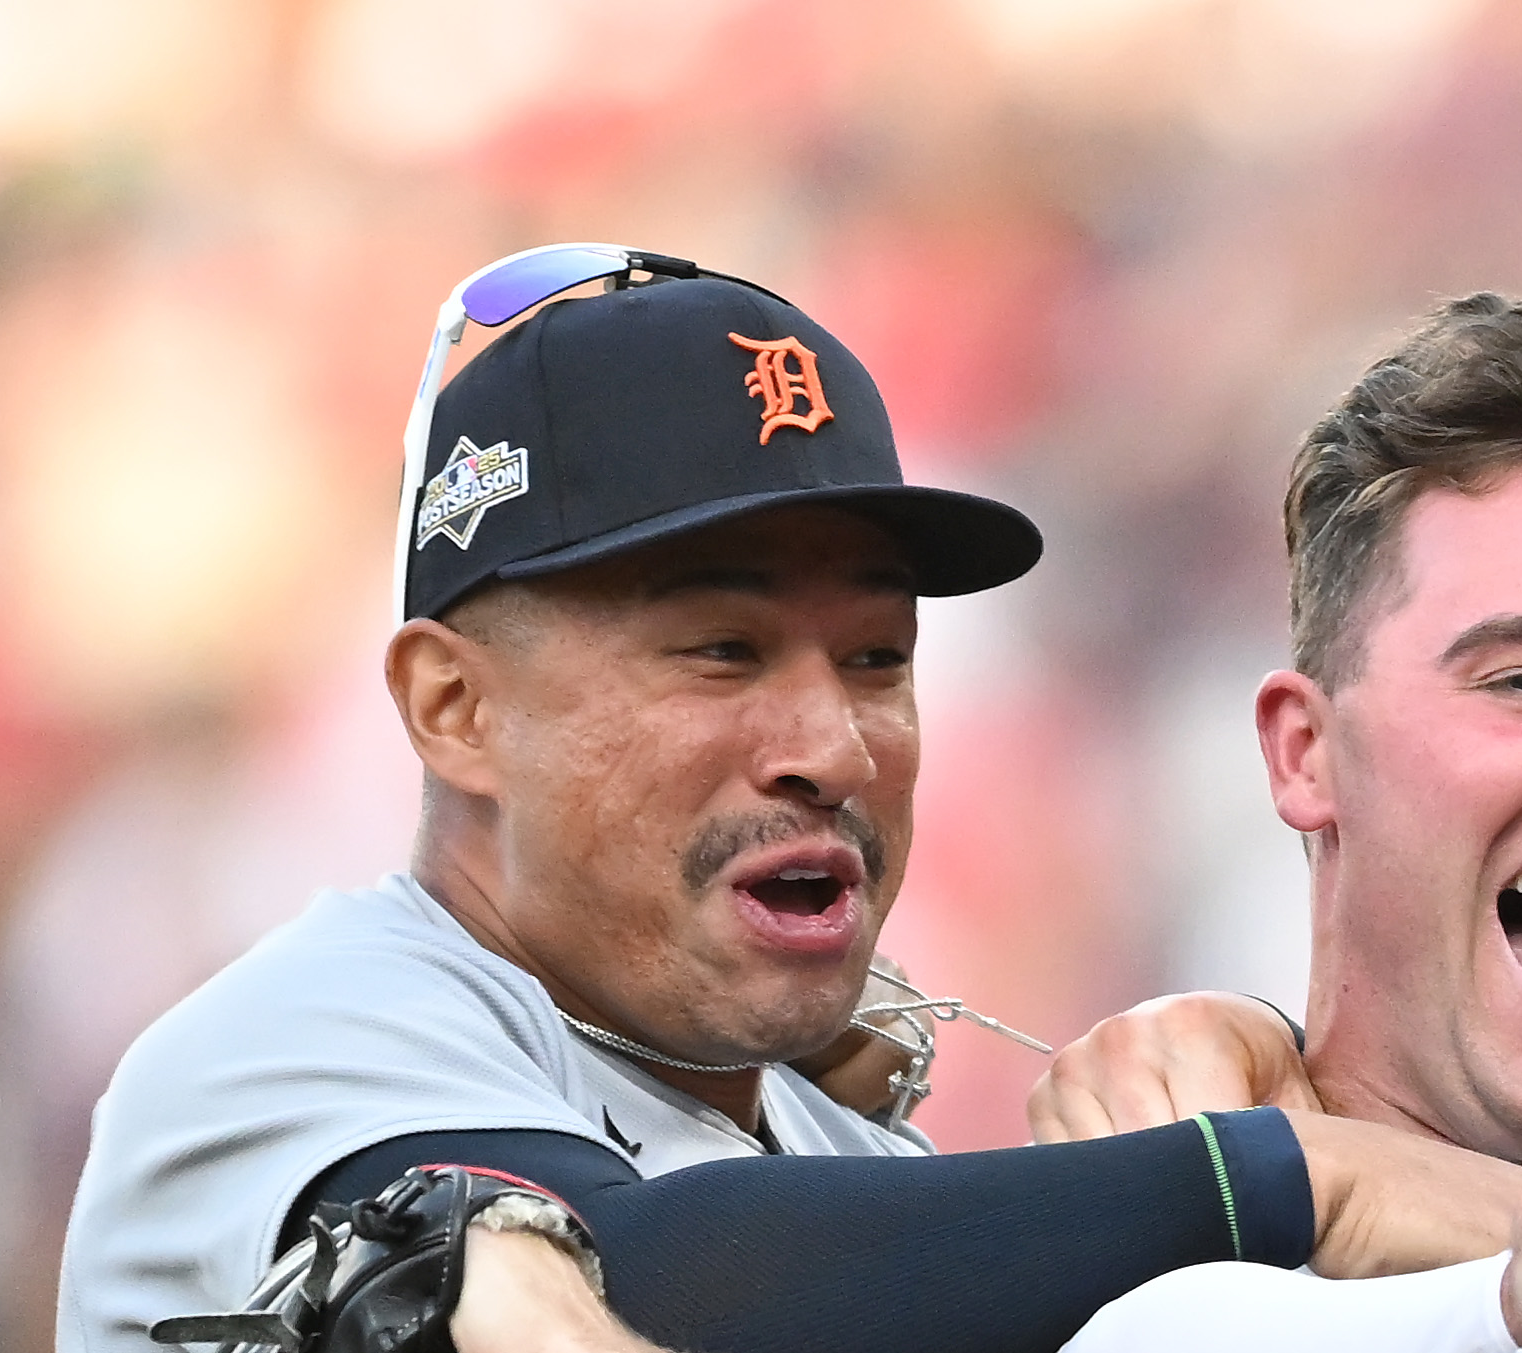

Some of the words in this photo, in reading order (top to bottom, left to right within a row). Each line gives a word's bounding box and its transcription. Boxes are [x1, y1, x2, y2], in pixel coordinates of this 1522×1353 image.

[728, 332, 835, 445] D
[419, 461, 521, 529] STSEASON
[478, 451, 501, 473] 25
